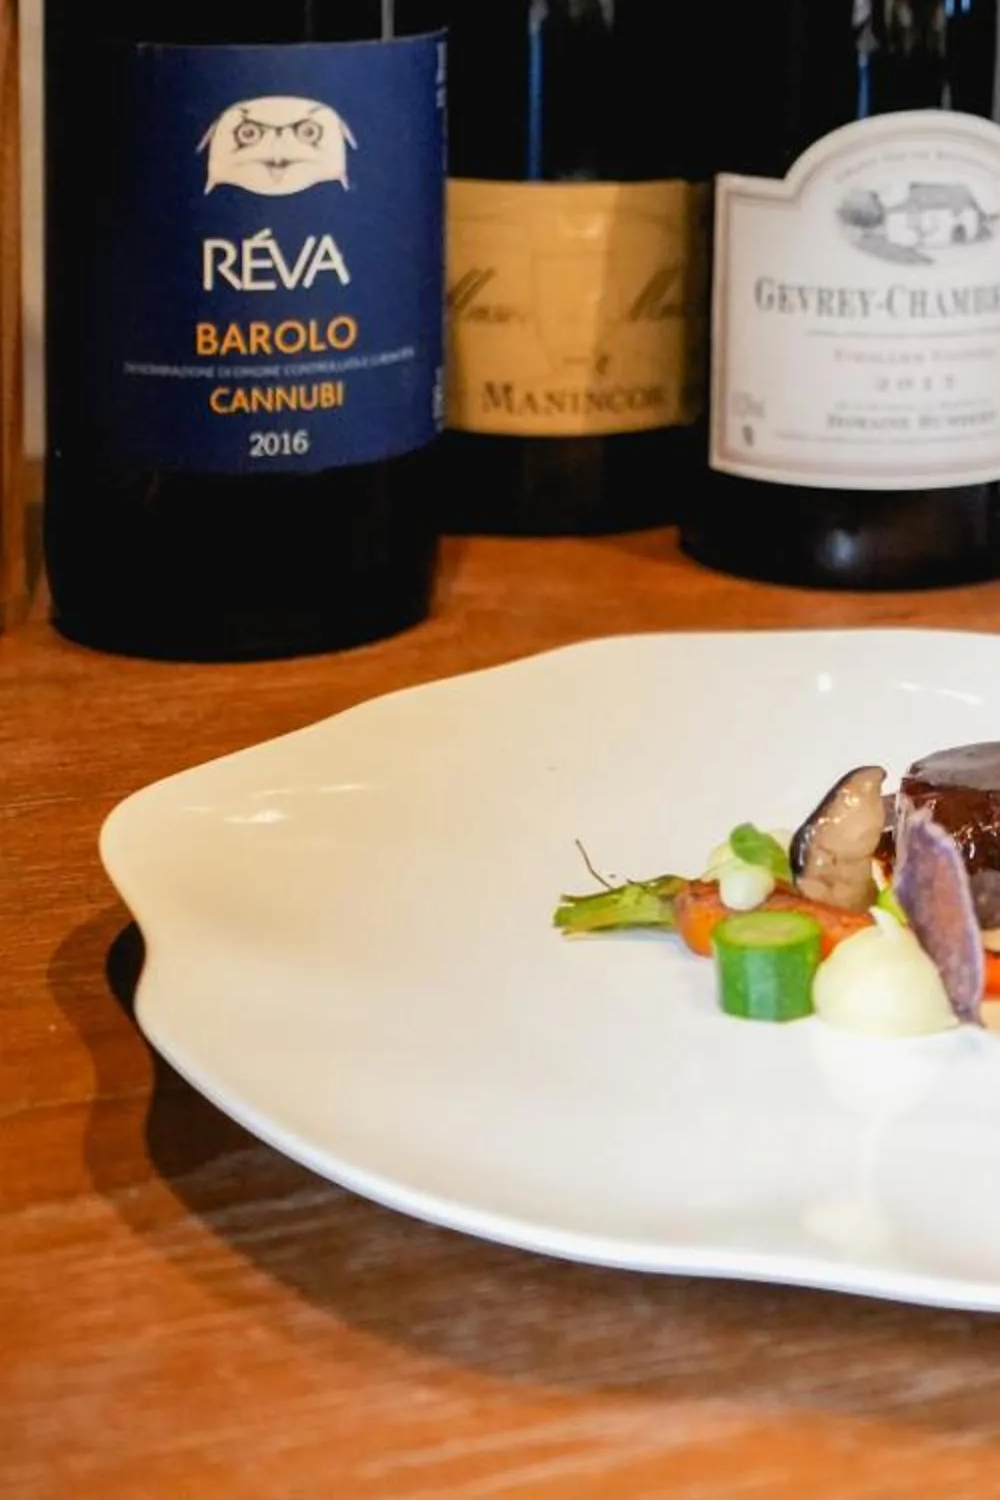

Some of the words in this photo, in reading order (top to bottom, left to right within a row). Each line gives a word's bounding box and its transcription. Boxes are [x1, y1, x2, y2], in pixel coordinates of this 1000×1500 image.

[203, 227, 350, 291] RÉVA
[195, 316, 358, 356] BAROLO
[209, 381, 345, 414] CANNUBI
[249, 430, 309, 457] 2016
